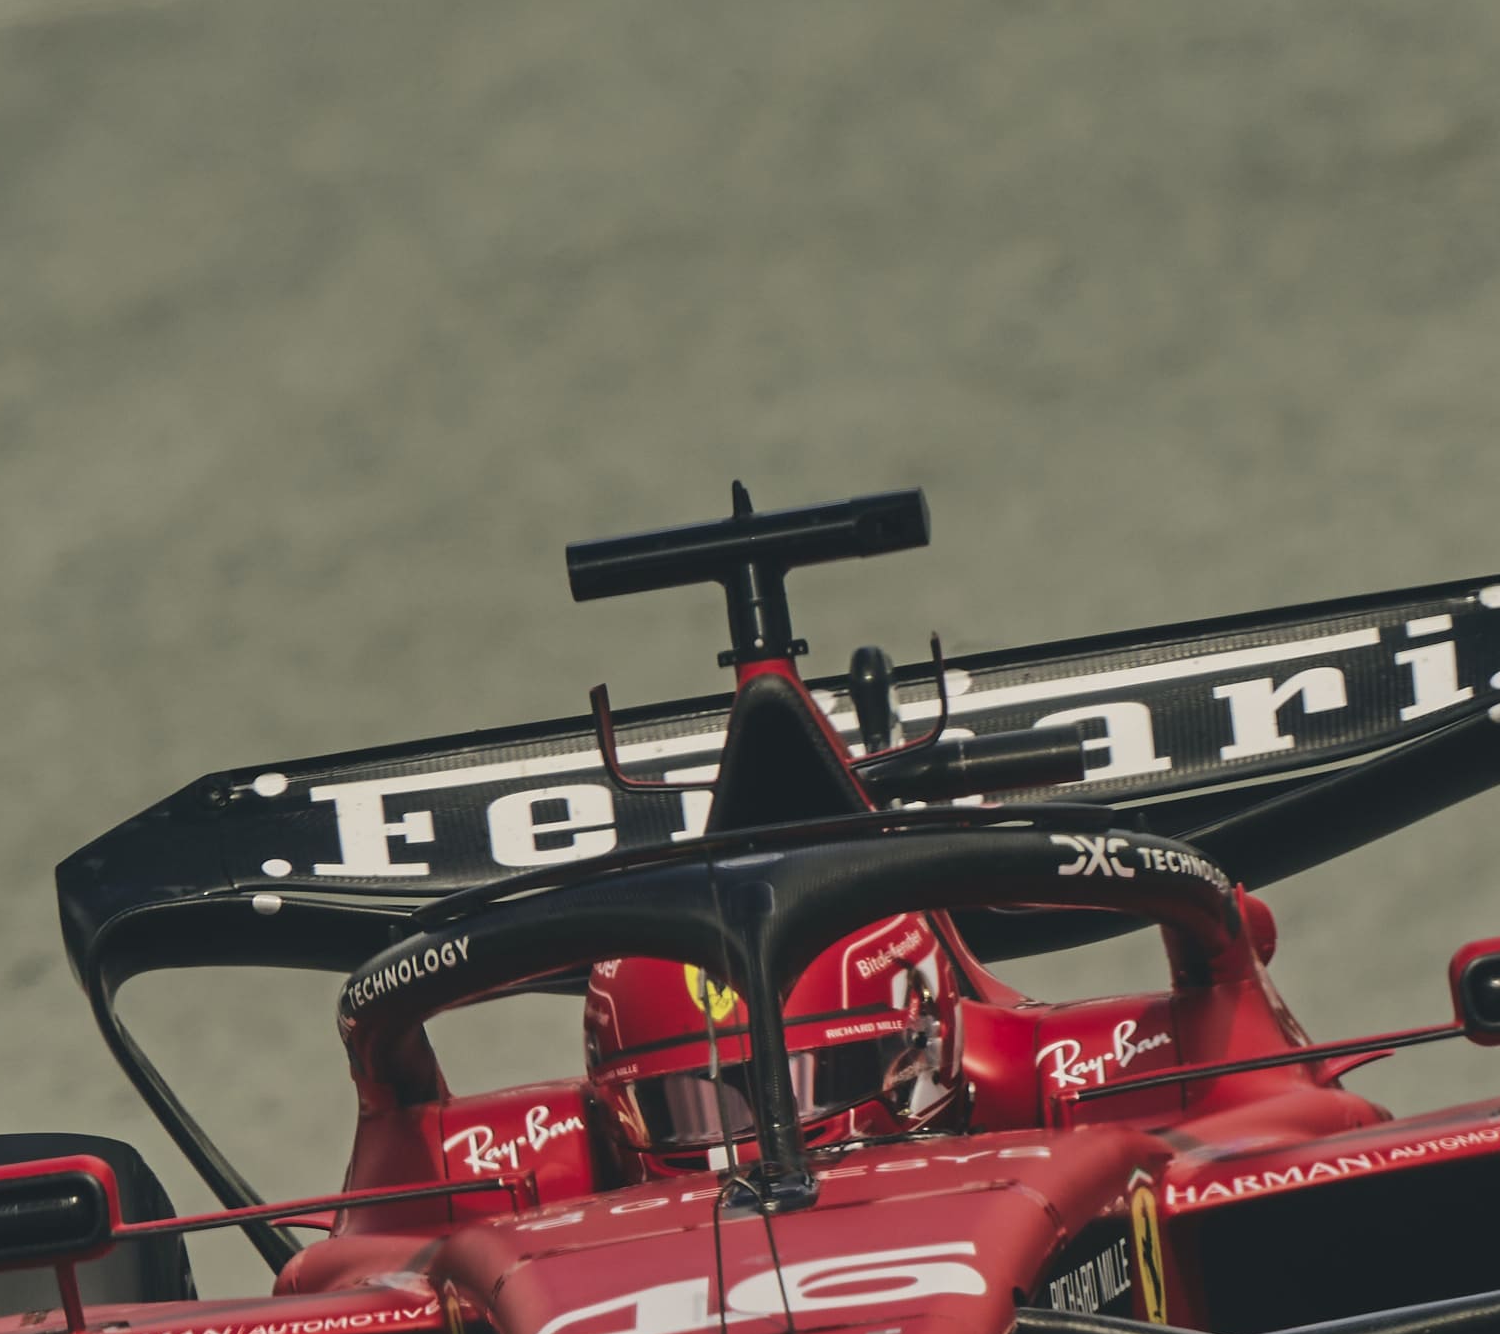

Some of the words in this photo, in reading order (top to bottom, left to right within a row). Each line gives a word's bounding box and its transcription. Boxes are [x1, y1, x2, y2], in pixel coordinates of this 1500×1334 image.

[309, 613, 1475, 879] Feari
[1050, 834, 1135, 878] DXC
[348, 935, 470, 1011] TECHNOLOGY
[855, 929, 923, 980] Bitdefender
[825, 1022, 876, 1039] RICHARD
[876, 1020, 904, 1031] MILLE
[1037, 1019, 1171, 1088] Ray-Ban
[443, 1104, 585, 1175] Ray-Ban
[610, 1146, 1051, 1215] GEESYS
[1166, 1153, 1373, 1207] HARMAN
[1049, 1260, 1100, 1314] RICHARD
[1097, 1237, 1132, 1304] MILLE
